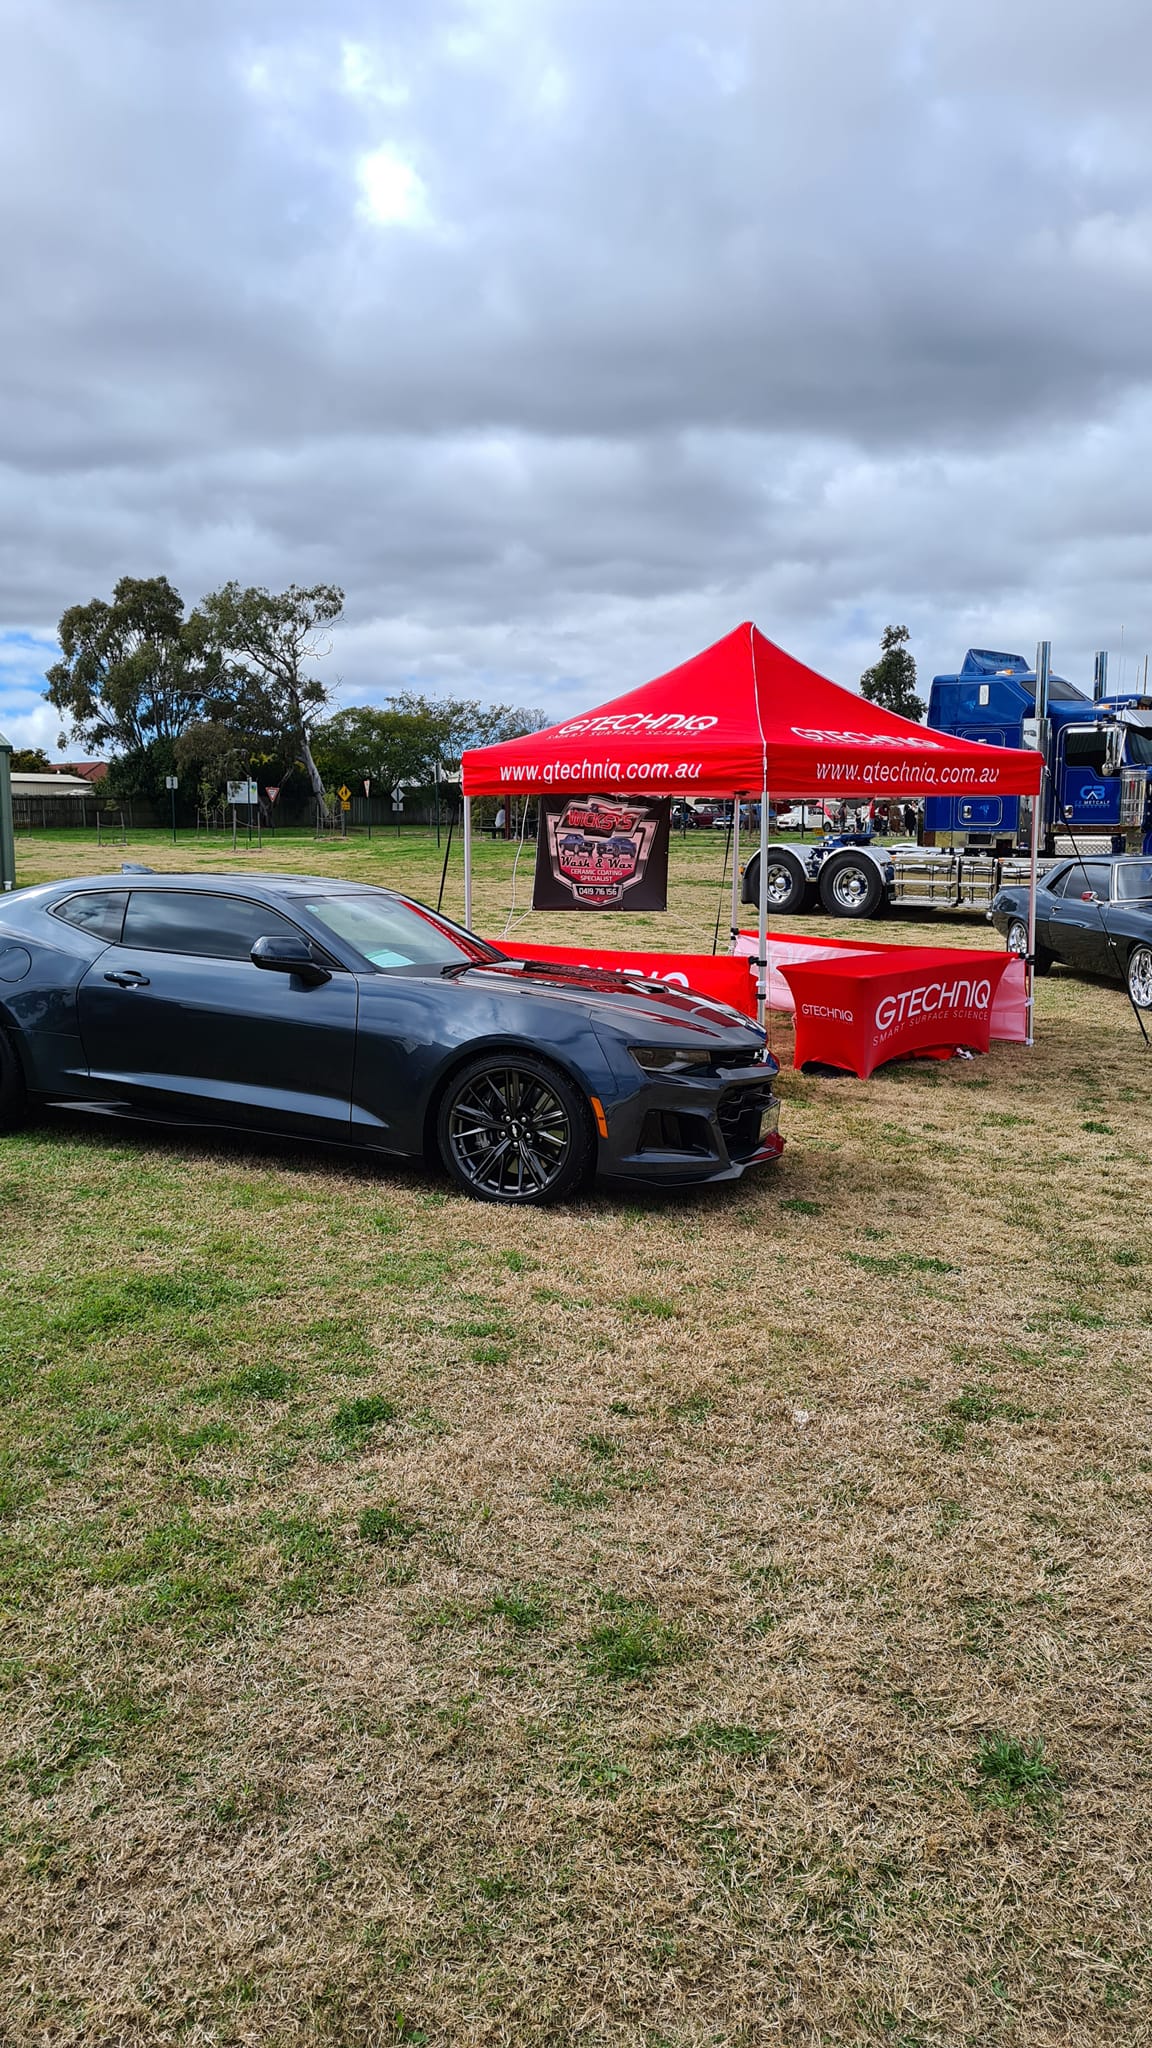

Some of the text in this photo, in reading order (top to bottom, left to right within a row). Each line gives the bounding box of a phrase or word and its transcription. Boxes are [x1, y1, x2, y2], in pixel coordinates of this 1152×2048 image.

[558, 713, 718, 735] GTECHNIQ
[499, 757, 702, 785] www.gtechniq.com.au
[816, 761, 1000, 786] www.gtechniq.com.au
[560, 856, 633, 869] Wash & Wax
[578, 887, 594, 895] 0419
[801, 1003, 854, 1022] GTECHNIQ
[875, 979, 991, 1031] GTECHNIQ
[872, 1010, 989, 1047] SMART SURFACE SCIENCE
